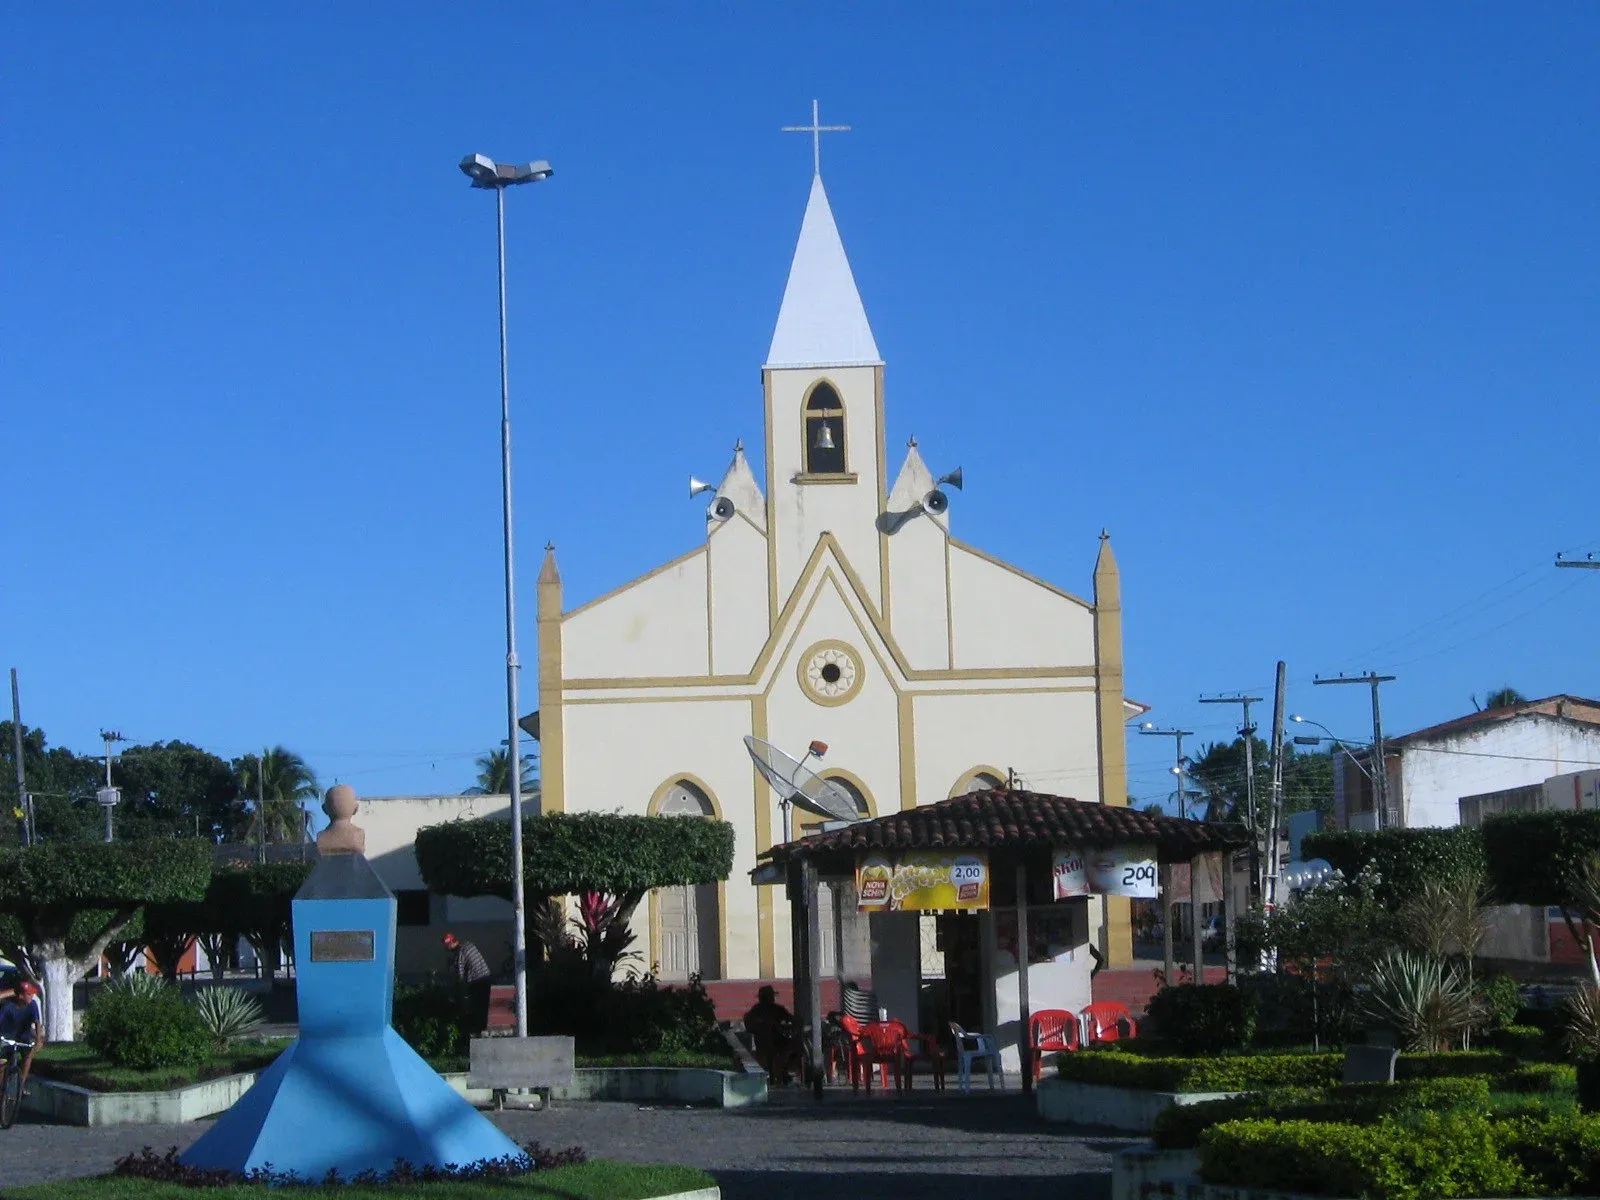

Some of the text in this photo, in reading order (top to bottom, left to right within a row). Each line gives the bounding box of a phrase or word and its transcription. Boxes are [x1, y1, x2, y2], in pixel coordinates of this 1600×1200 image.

[955, 867, 980, 879] 2,00
[866, 881, 886, 889] NOVA
[862, 888, 885, 897] SCHIN
